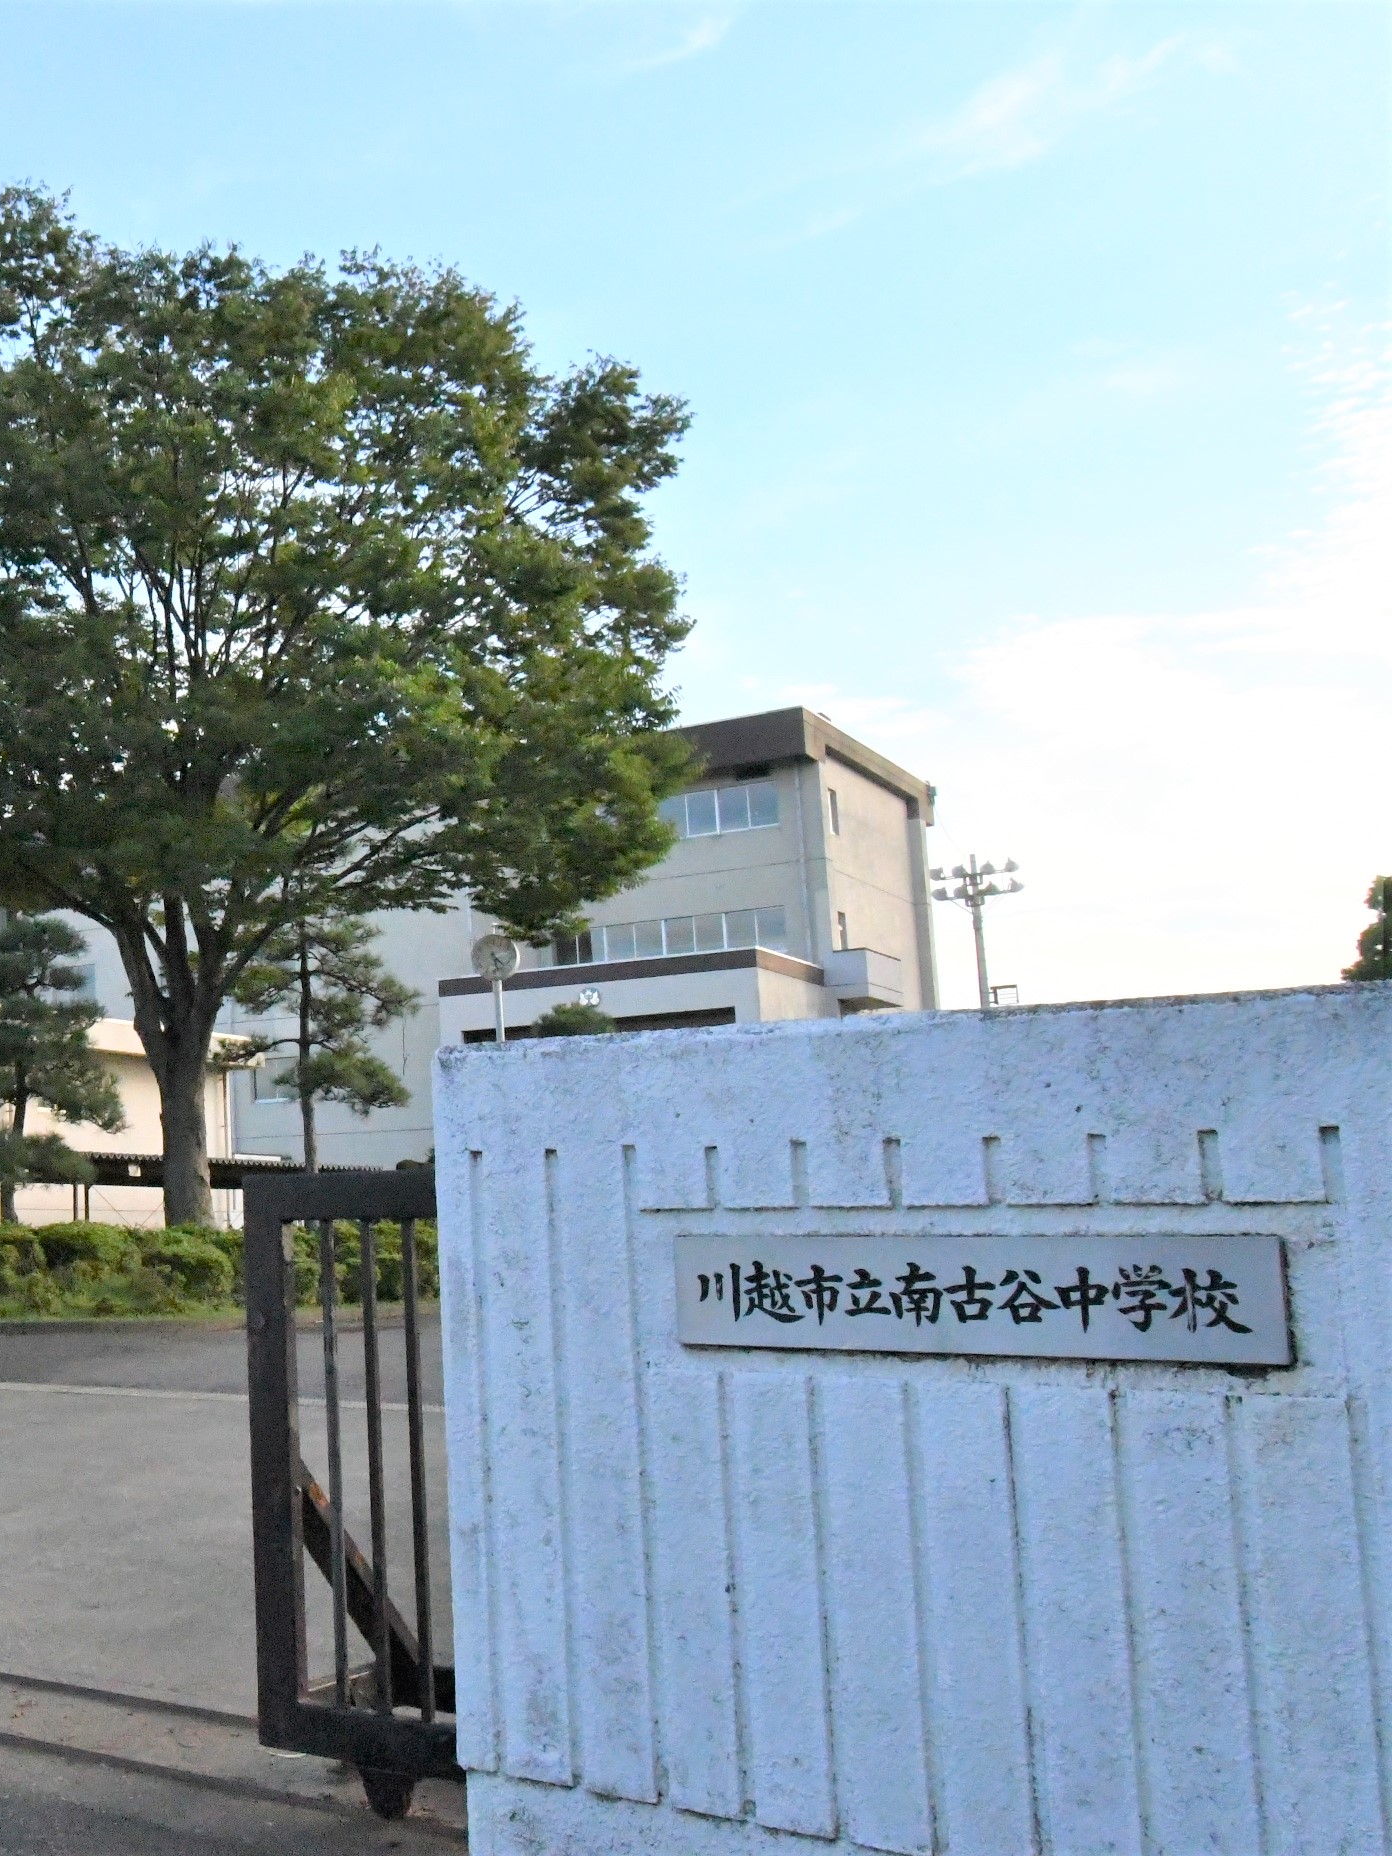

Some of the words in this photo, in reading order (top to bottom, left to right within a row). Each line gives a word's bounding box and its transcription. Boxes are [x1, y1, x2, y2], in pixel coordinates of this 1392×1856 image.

[697, 1260, 1254, 1334] 川越市立南古谷中学校
